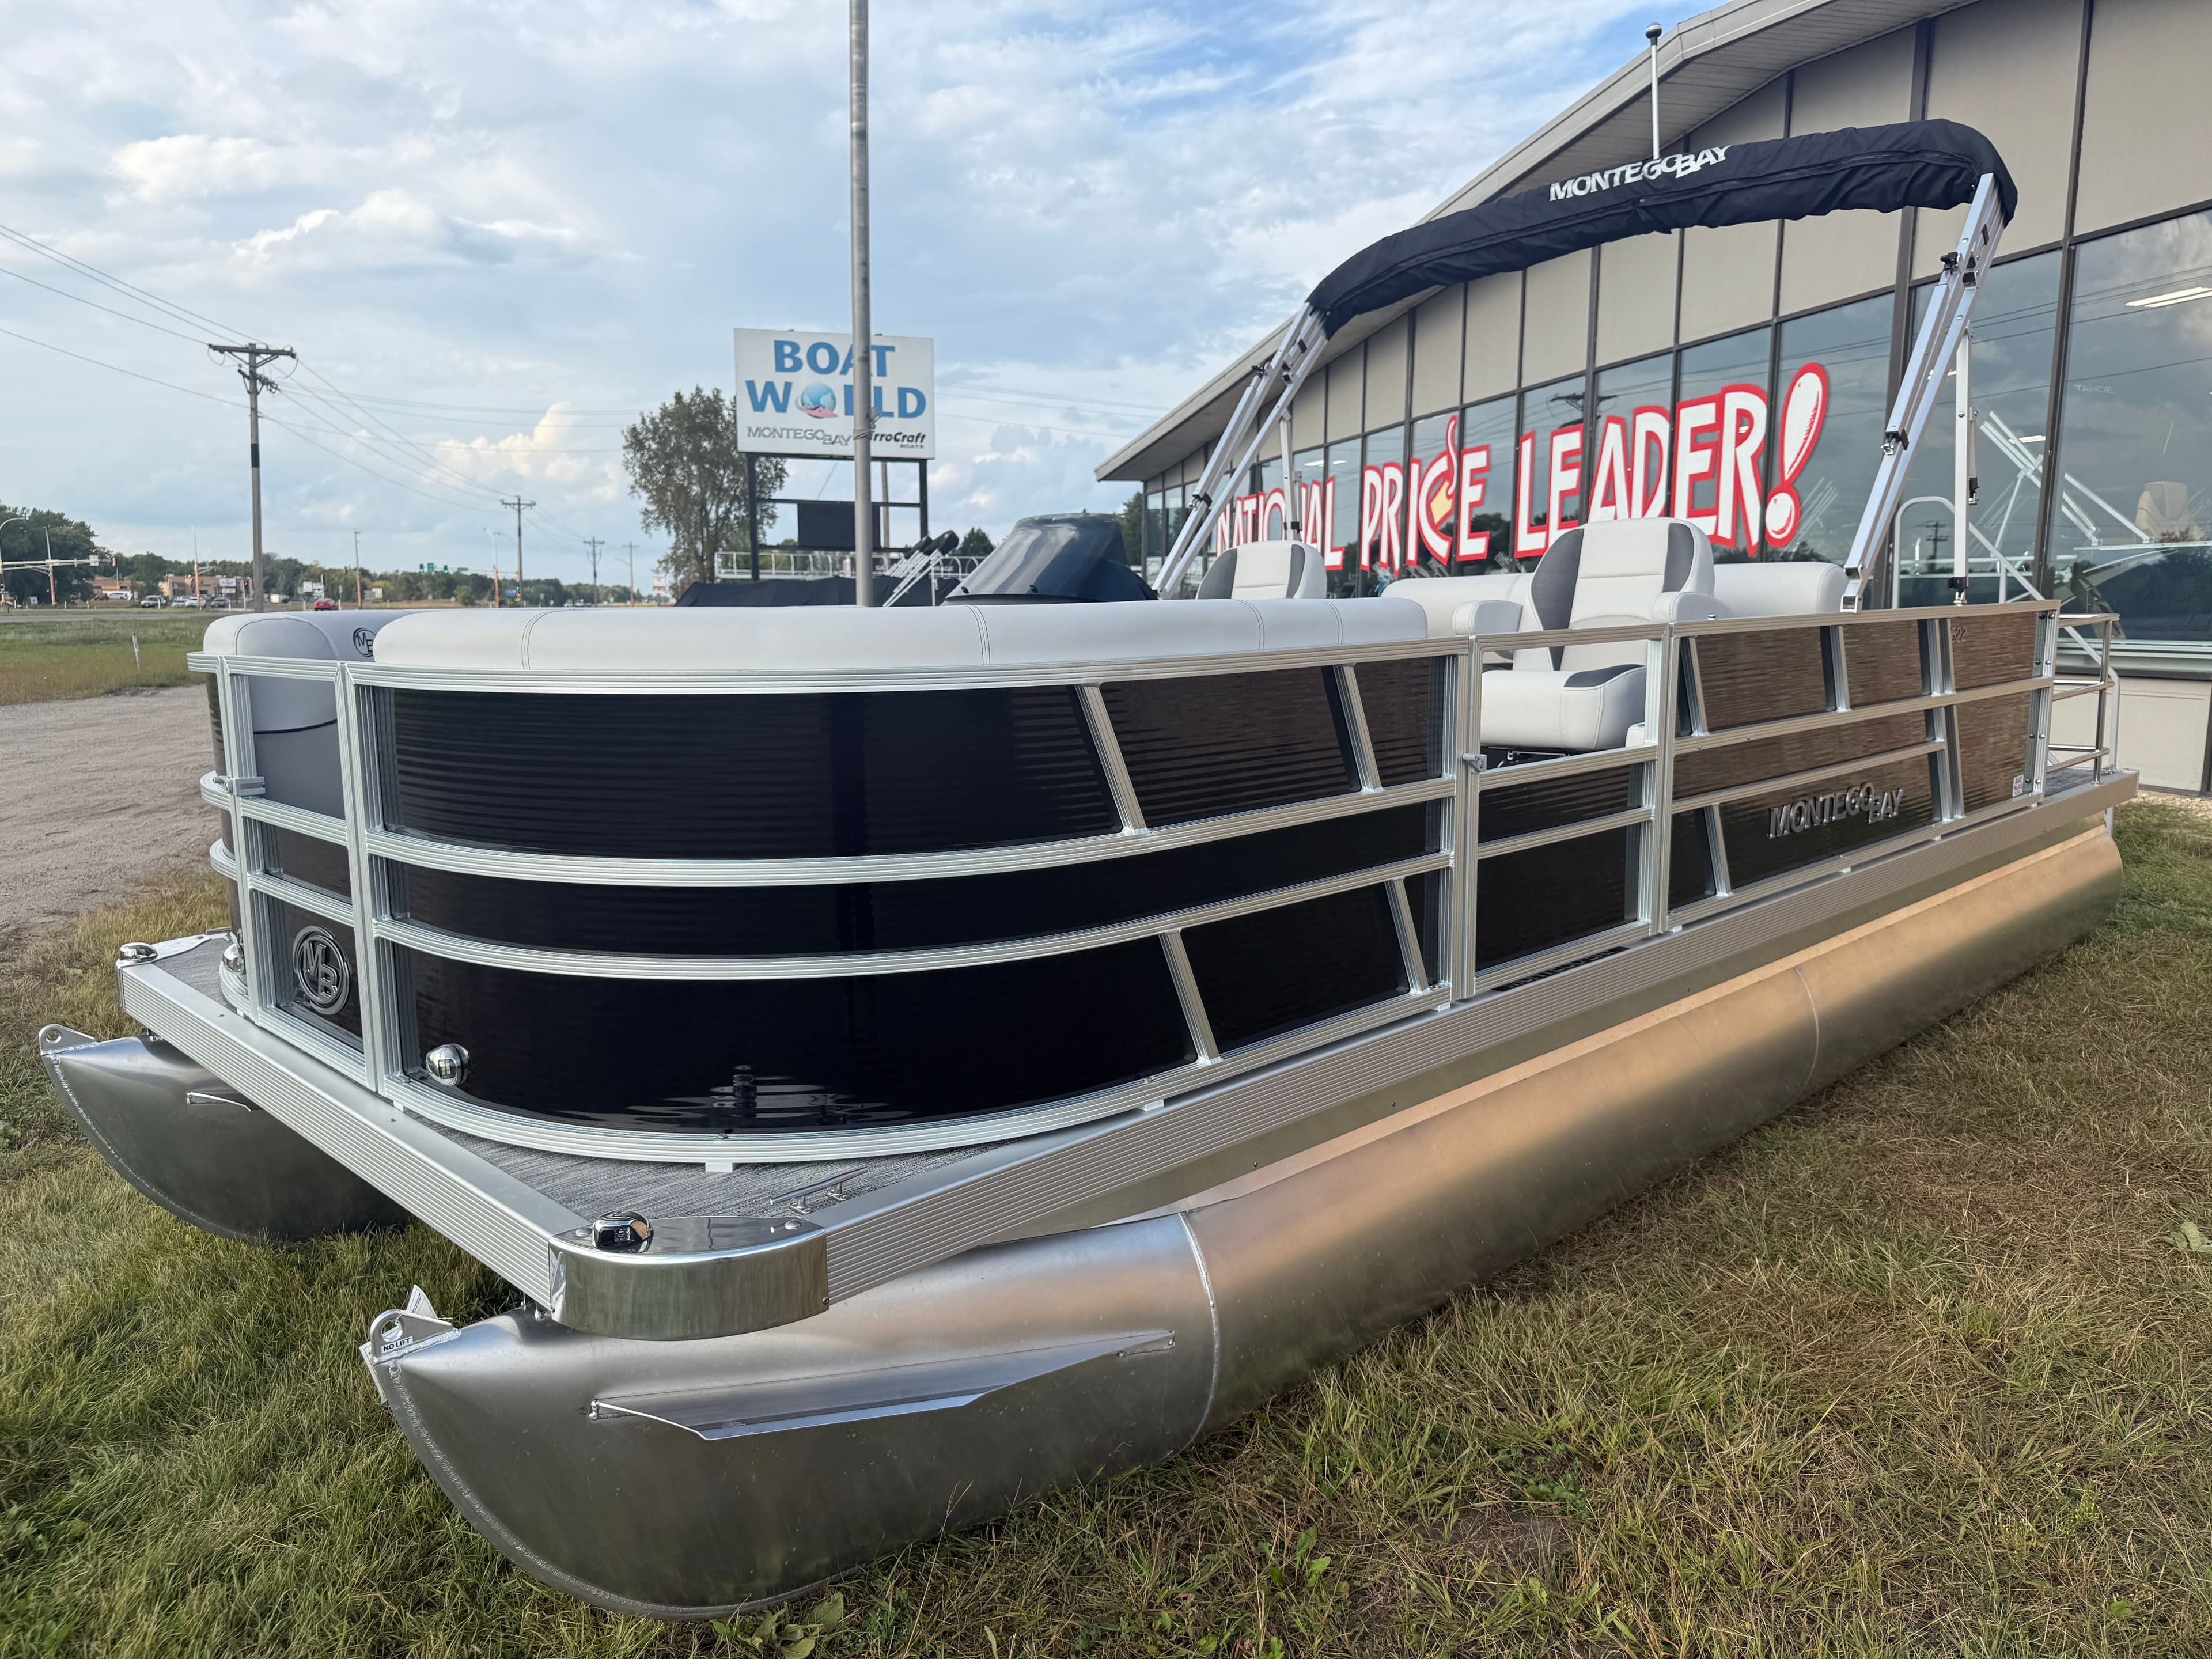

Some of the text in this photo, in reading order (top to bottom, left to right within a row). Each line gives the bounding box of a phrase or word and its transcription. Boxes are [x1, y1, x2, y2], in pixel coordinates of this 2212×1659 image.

[870, 431, 926, 443] rroCraft
[1216, 362, 1828, 578] NATIOAL PRICE LEADER!
[396, 1338, 410, 1347] LIFT
